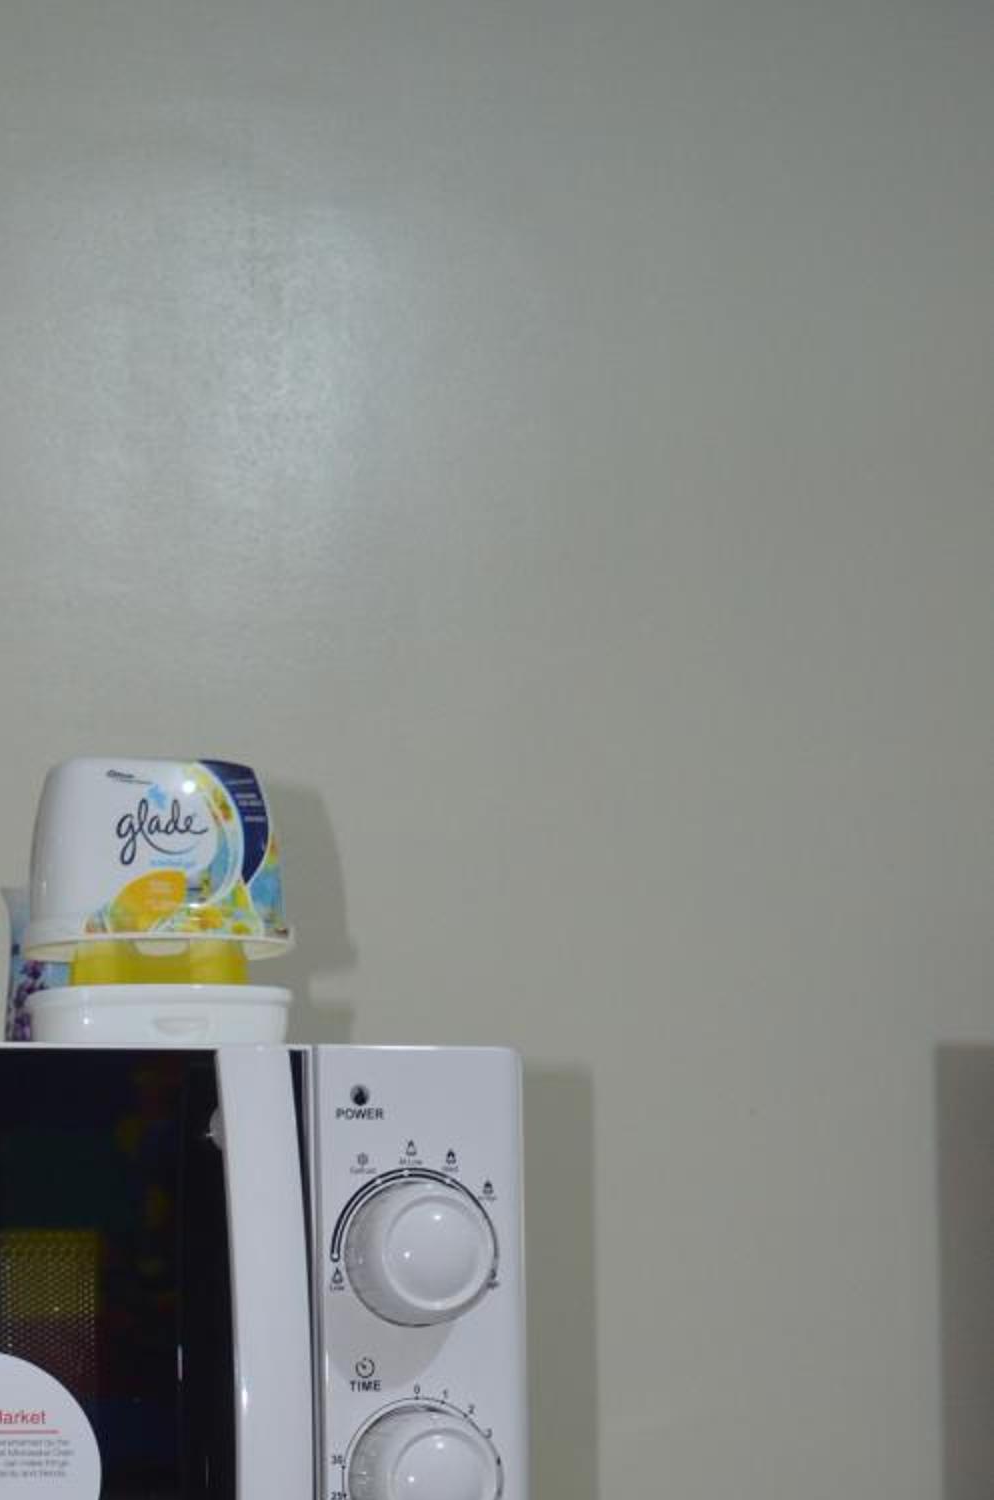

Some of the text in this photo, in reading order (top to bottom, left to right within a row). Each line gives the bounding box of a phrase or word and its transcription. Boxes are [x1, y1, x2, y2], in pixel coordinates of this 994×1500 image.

[116, 798, 208, 865] glade
[336, 1107, 384, 1120] POWER
[350, 1380, 382, 1391] TIME
[413, 1384, 421, 1395] 0
[467, 1403, 476, 1414] 2
